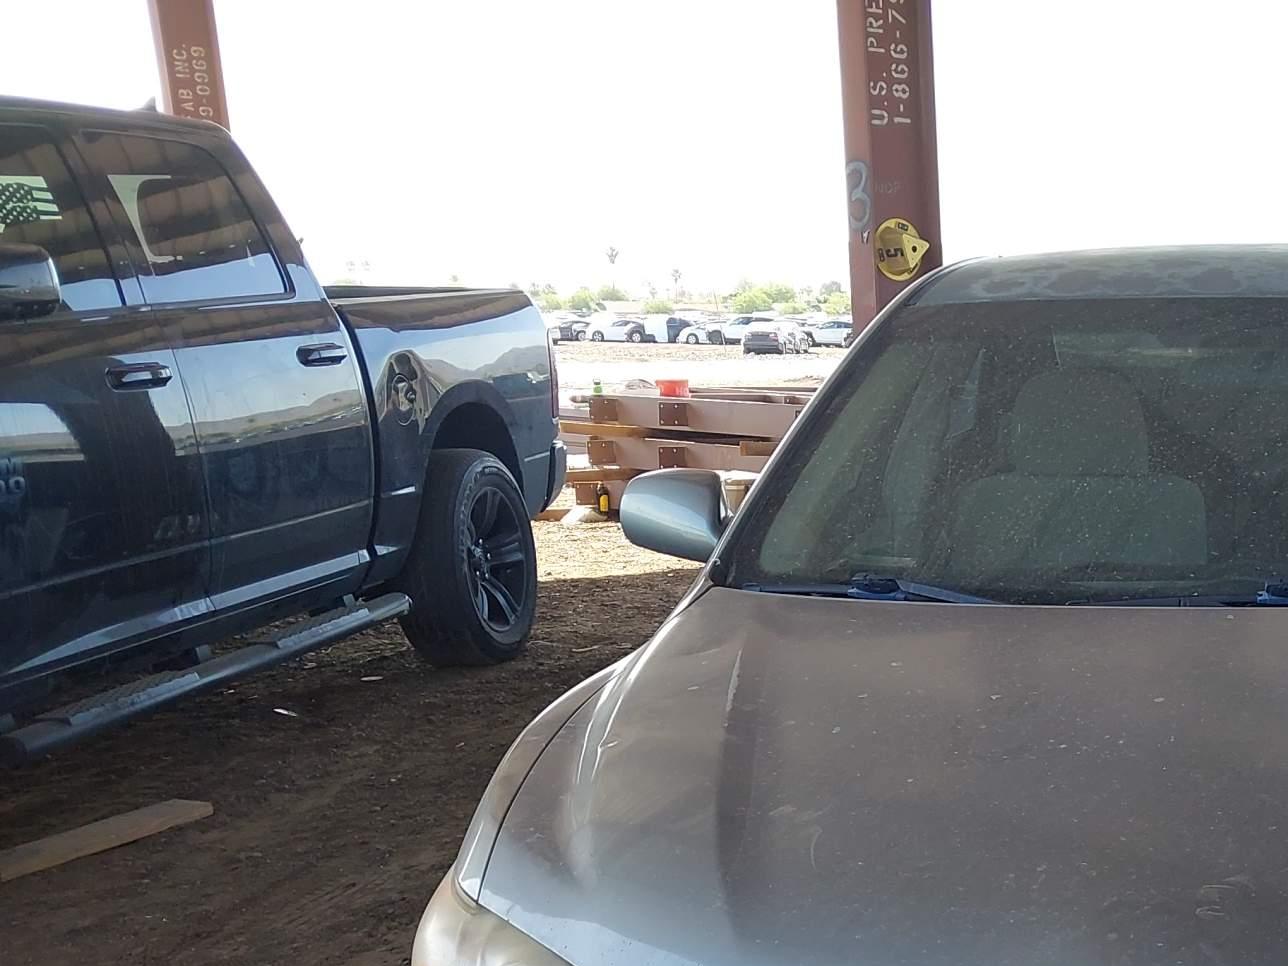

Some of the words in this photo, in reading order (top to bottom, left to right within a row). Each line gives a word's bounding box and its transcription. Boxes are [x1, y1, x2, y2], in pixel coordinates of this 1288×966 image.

[172, 43, 191, 78] INC.
[178, 88, 195, 119] AB
[870, 72, 888, 126] U.S.
